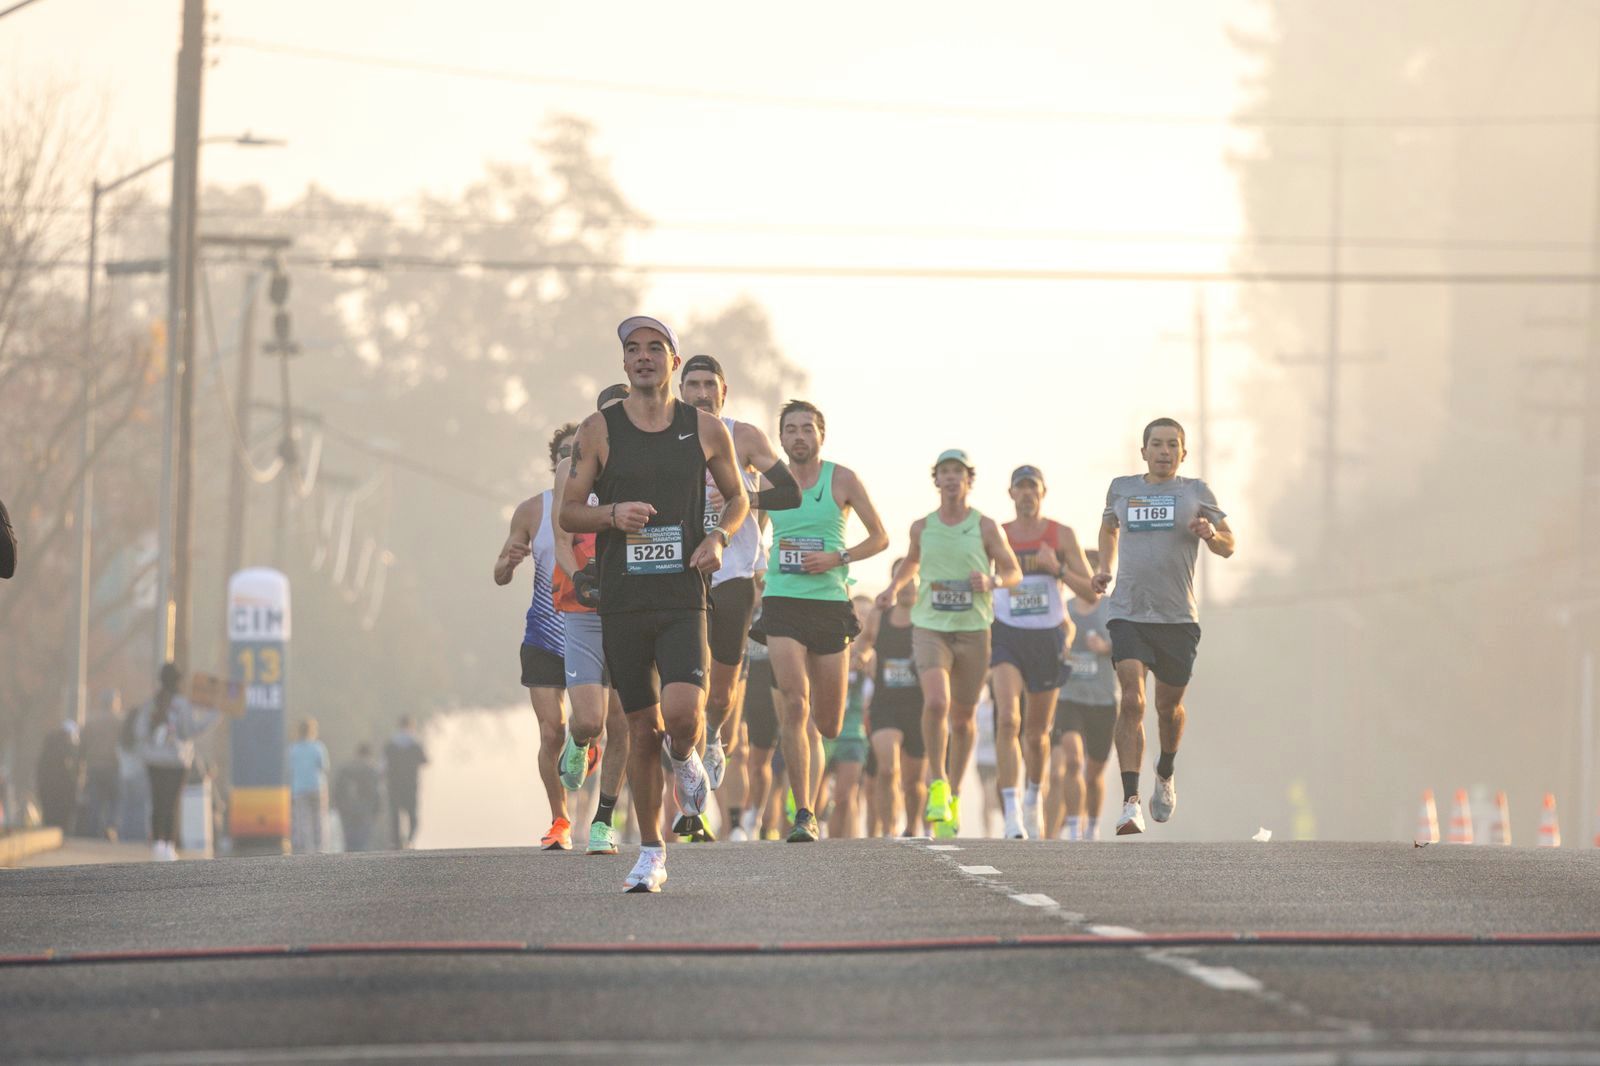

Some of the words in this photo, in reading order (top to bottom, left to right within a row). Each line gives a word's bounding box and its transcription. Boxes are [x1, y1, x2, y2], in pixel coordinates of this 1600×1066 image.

[1135, 507, 1168, 520] 1169
[633, 544, 675, 561] 5226
[239, 646, 281, 685] 13
